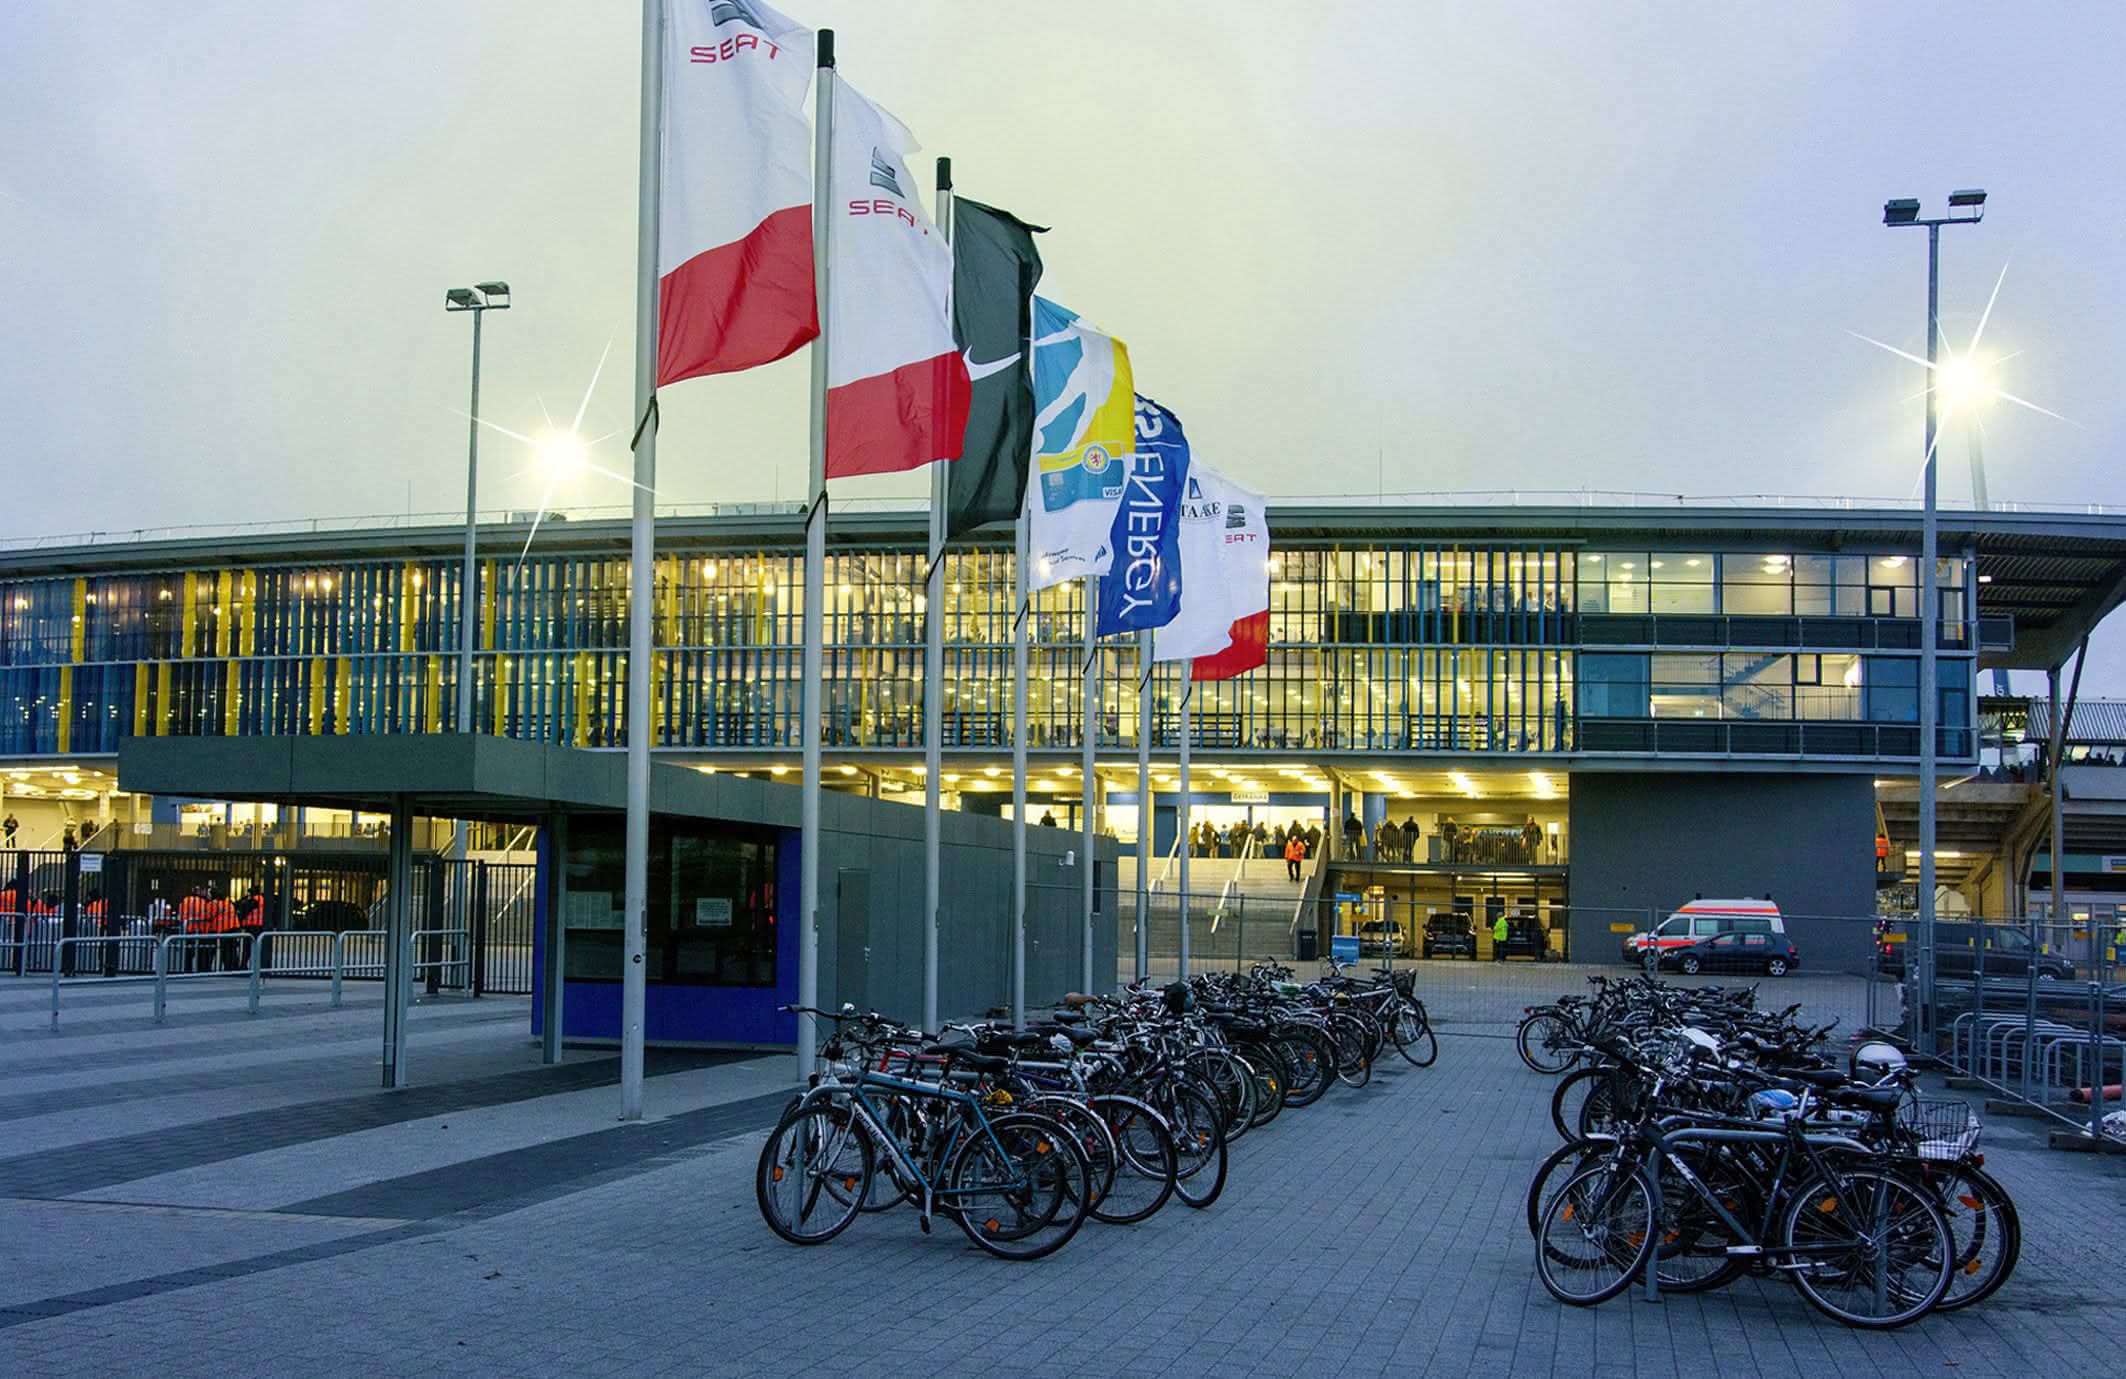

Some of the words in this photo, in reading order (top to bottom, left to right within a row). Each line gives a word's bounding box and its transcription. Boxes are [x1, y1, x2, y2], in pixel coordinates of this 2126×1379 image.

[690, 33, 779, 63] SEAT
[848, 199, 929, 236] SEA
[1225, 533, 1257, 544] EAT
